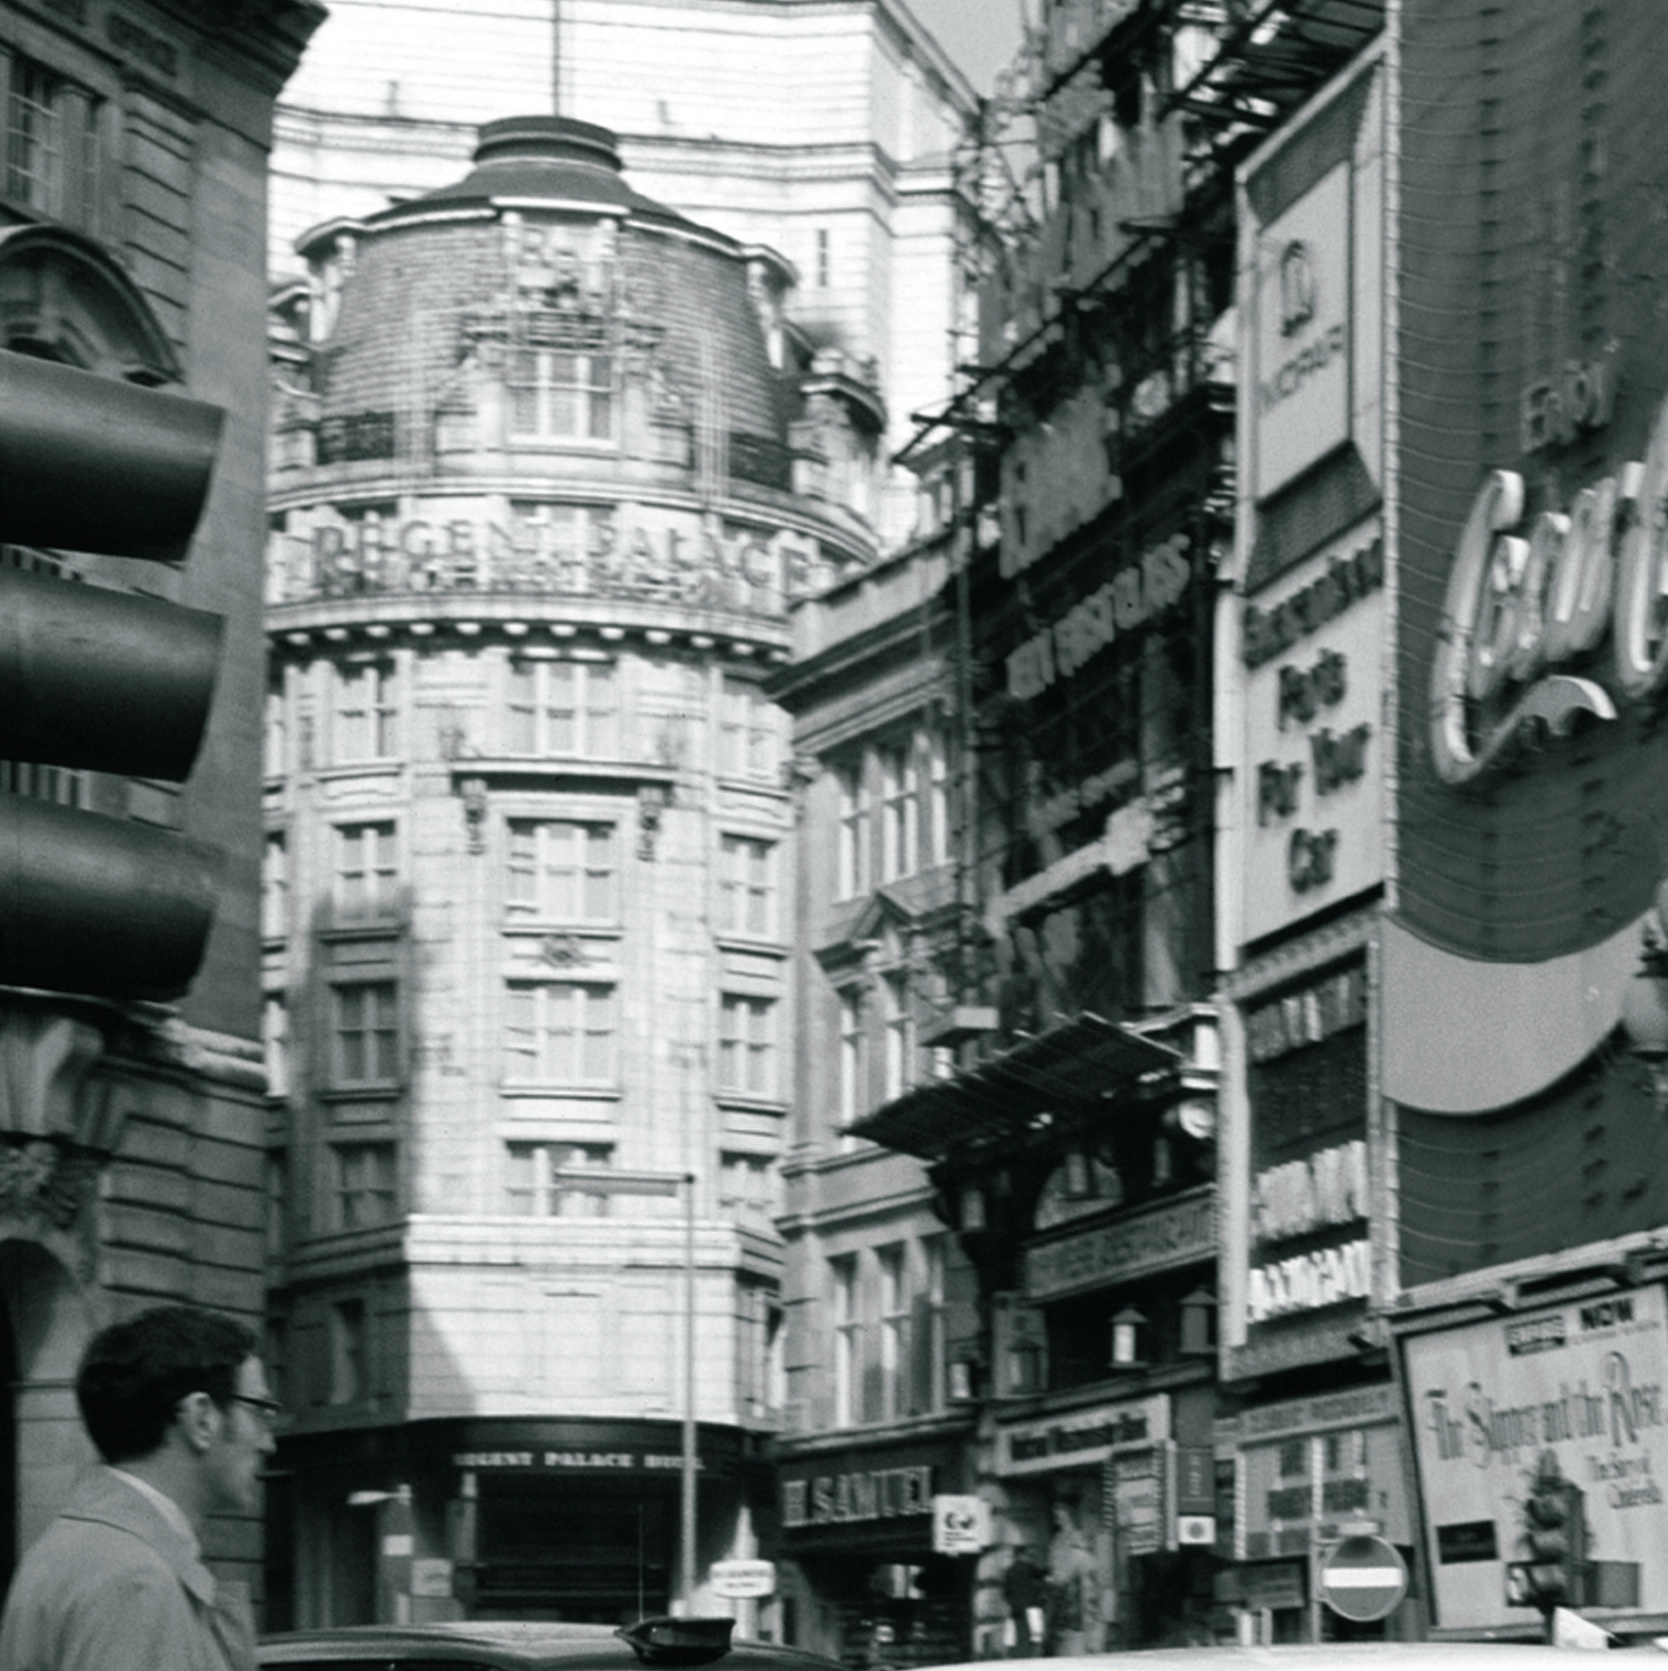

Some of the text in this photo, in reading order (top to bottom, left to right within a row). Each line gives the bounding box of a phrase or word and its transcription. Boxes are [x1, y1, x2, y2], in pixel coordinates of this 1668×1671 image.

[1580, 1297, 1635, 1332] NOW
[1423, 1387, 1466, 1461] The
[1602, 1350, 1664, 1448] Rose
[544, 1451, 635, 1468] PALACE
